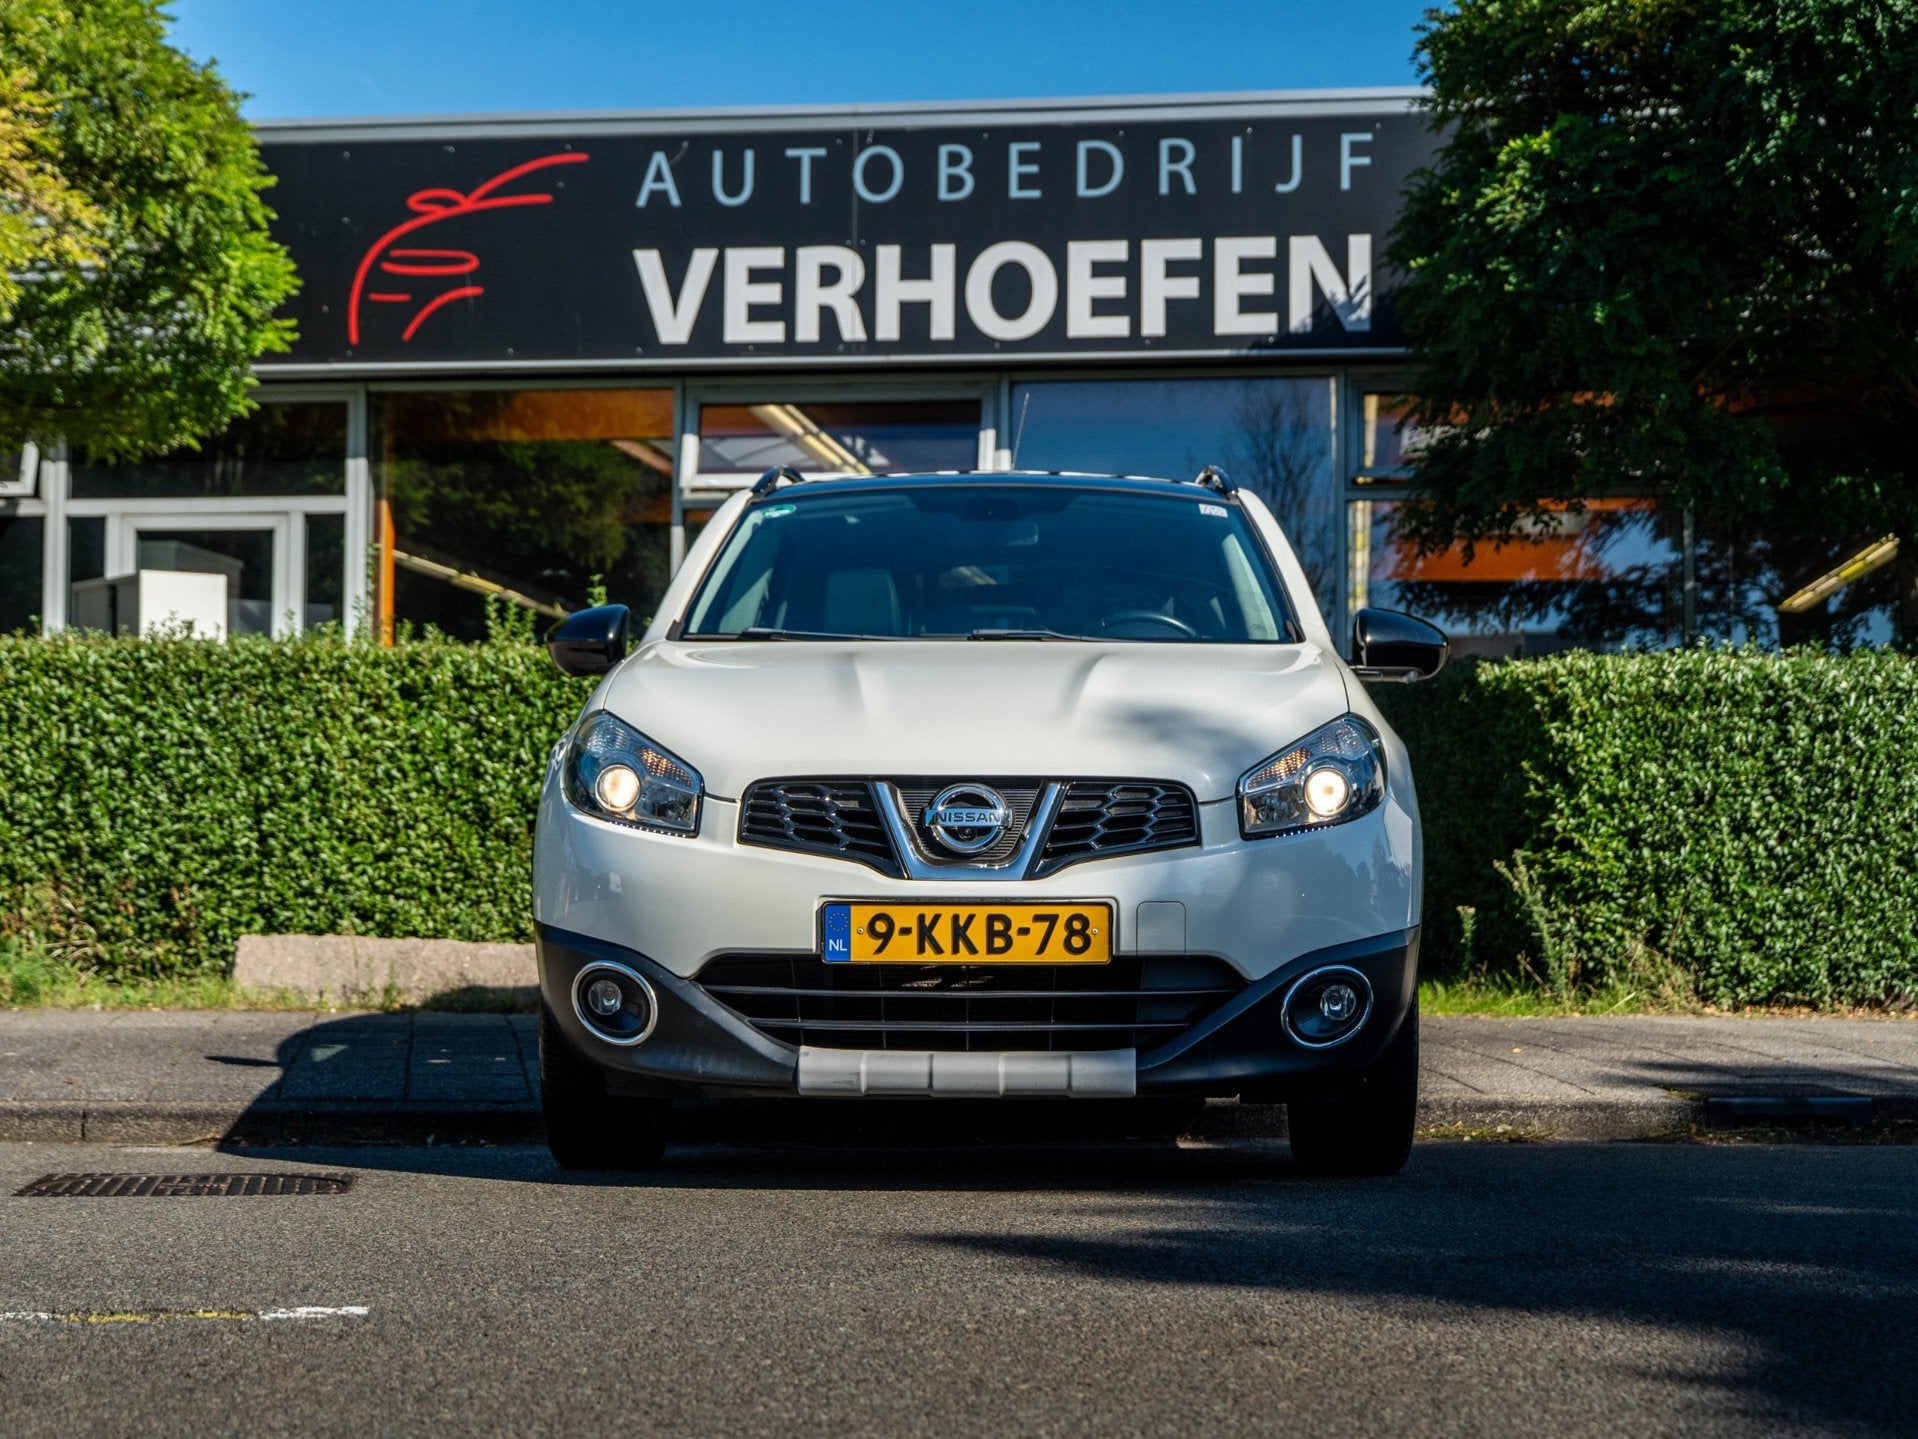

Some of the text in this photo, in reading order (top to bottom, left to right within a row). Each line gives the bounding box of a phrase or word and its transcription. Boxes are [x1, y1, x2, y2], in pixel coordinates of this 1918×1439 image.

[634, 132, 1375, 208] AUTOBEDRIJF
[632, 233, 1372, 345] VERHOEFEN
[934, 811, 1002, 823] NISSAN
[828, 939, 848, 952] NL
[866, 913, 1092, 955] 9-KKB-78
